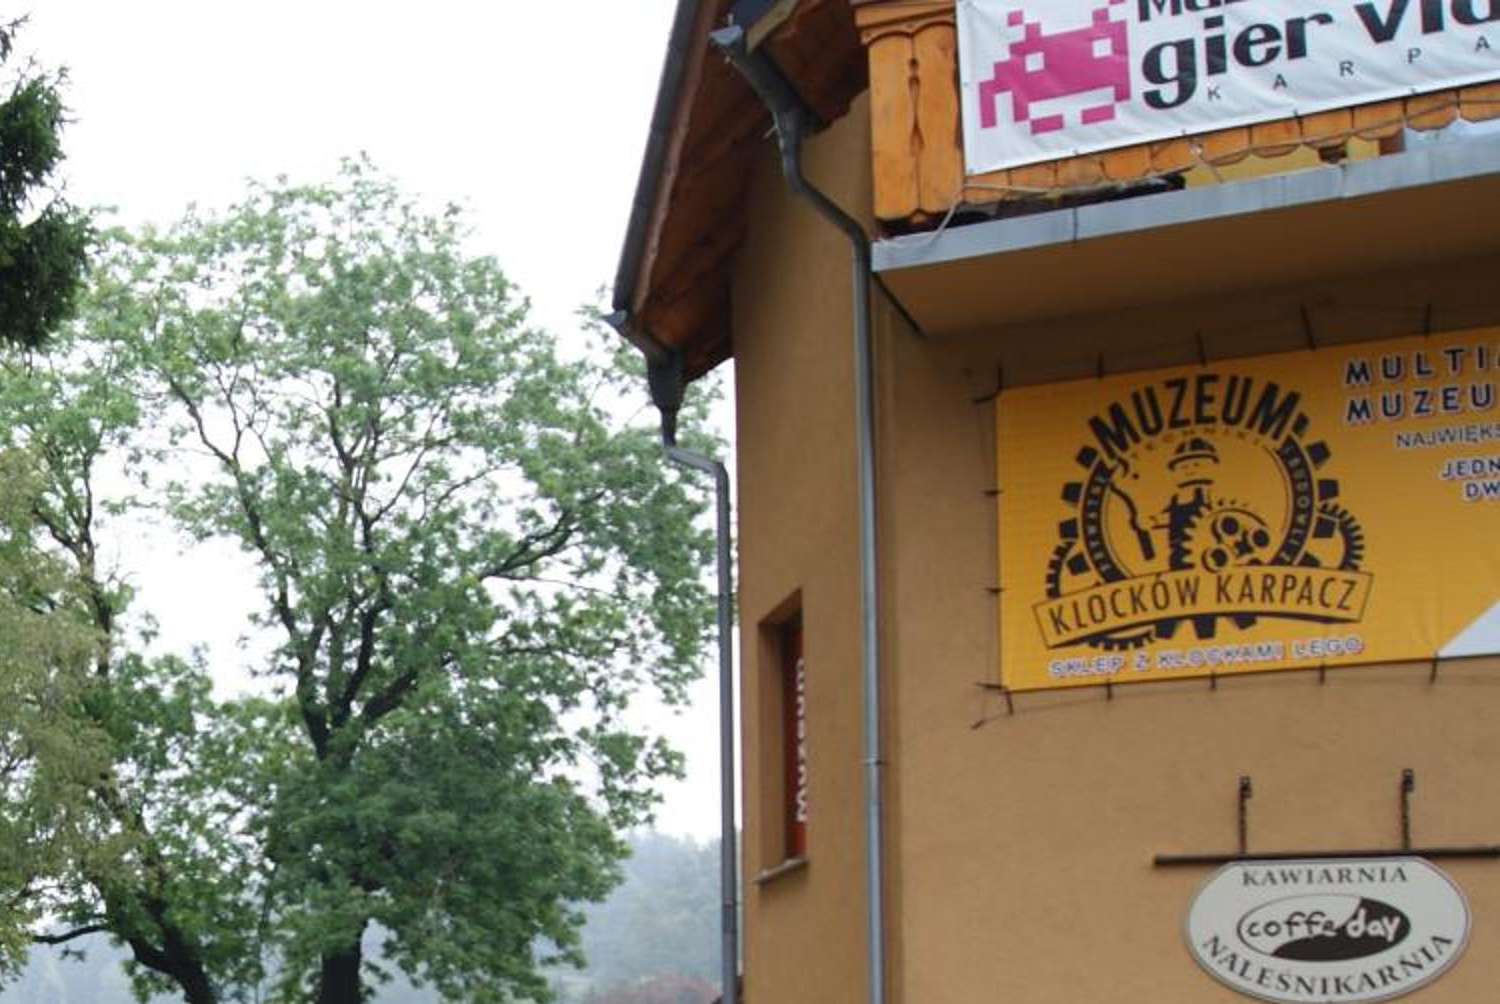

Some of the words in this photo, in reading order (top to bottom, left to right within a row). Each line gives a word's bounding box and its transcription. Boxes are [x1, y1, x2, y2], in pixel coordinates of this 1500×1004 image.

[1142, 12, 1333, 110] gier
[1345, 346, 1500, 384] MULTI
[1089, 373, 1301, 460] MUZEUM
[1049, 573, 1200, 635] KLOCKÓW
[1216, 572, 1357, 612] KARPACZ
[1292, 636, 1364, 658] LEGO
[1242, 864, 1409, 887] KAWIARNIA
[1247, 910, 1337, 938] coffe
[1346, 908, 1401, 942] day
